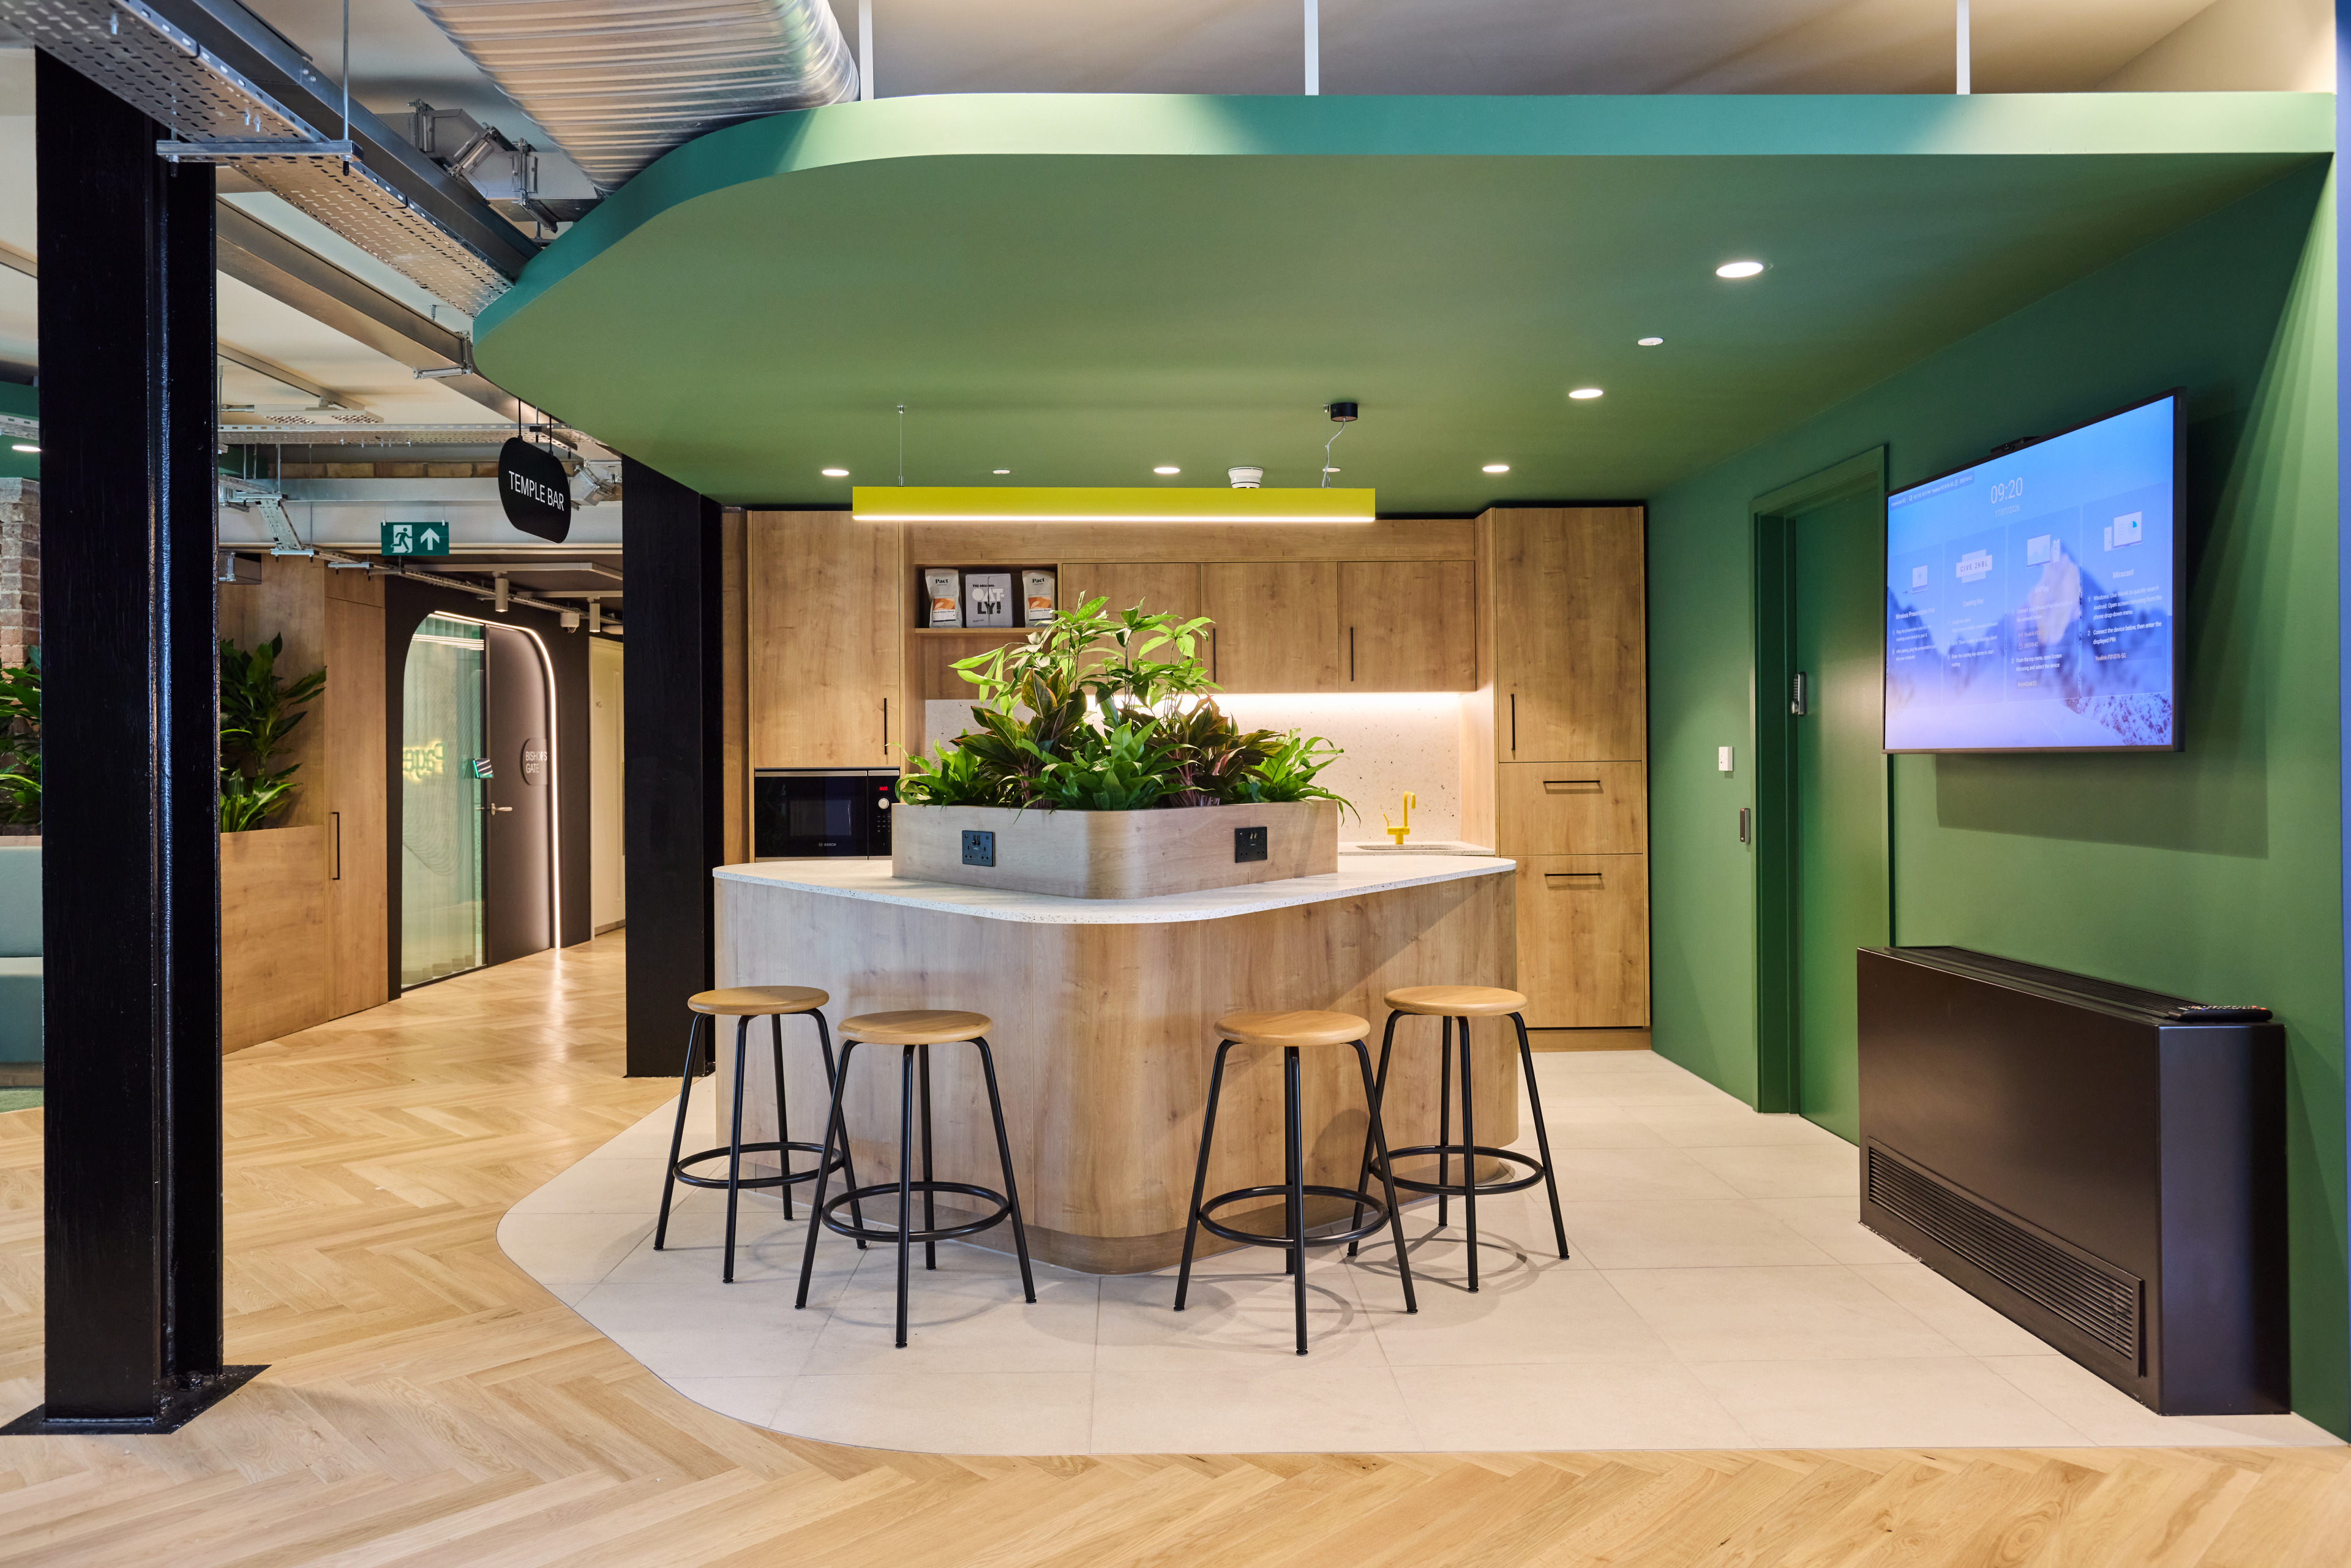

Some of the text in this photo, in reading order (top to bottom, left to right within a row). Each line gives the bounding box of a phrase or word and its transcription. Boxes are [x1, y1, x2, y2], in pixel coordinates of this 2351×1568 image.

[508, 470, 564, 511] TEMPLE BAR
[1991, 477, 2022, 504] 09:20
[1995, 504, 2020, 517] 17/07/2026
[1960, 560, 1988, 572] CIVE 2KBL
[2112, 569, 2134, 579] Miracast
[977, 601, 1002, 615] LY!
[1908, 609, 1928, 617] Presentation
[525, 751, 548, 762] BISHOPS
[525, 763, 539, 773] GATE
